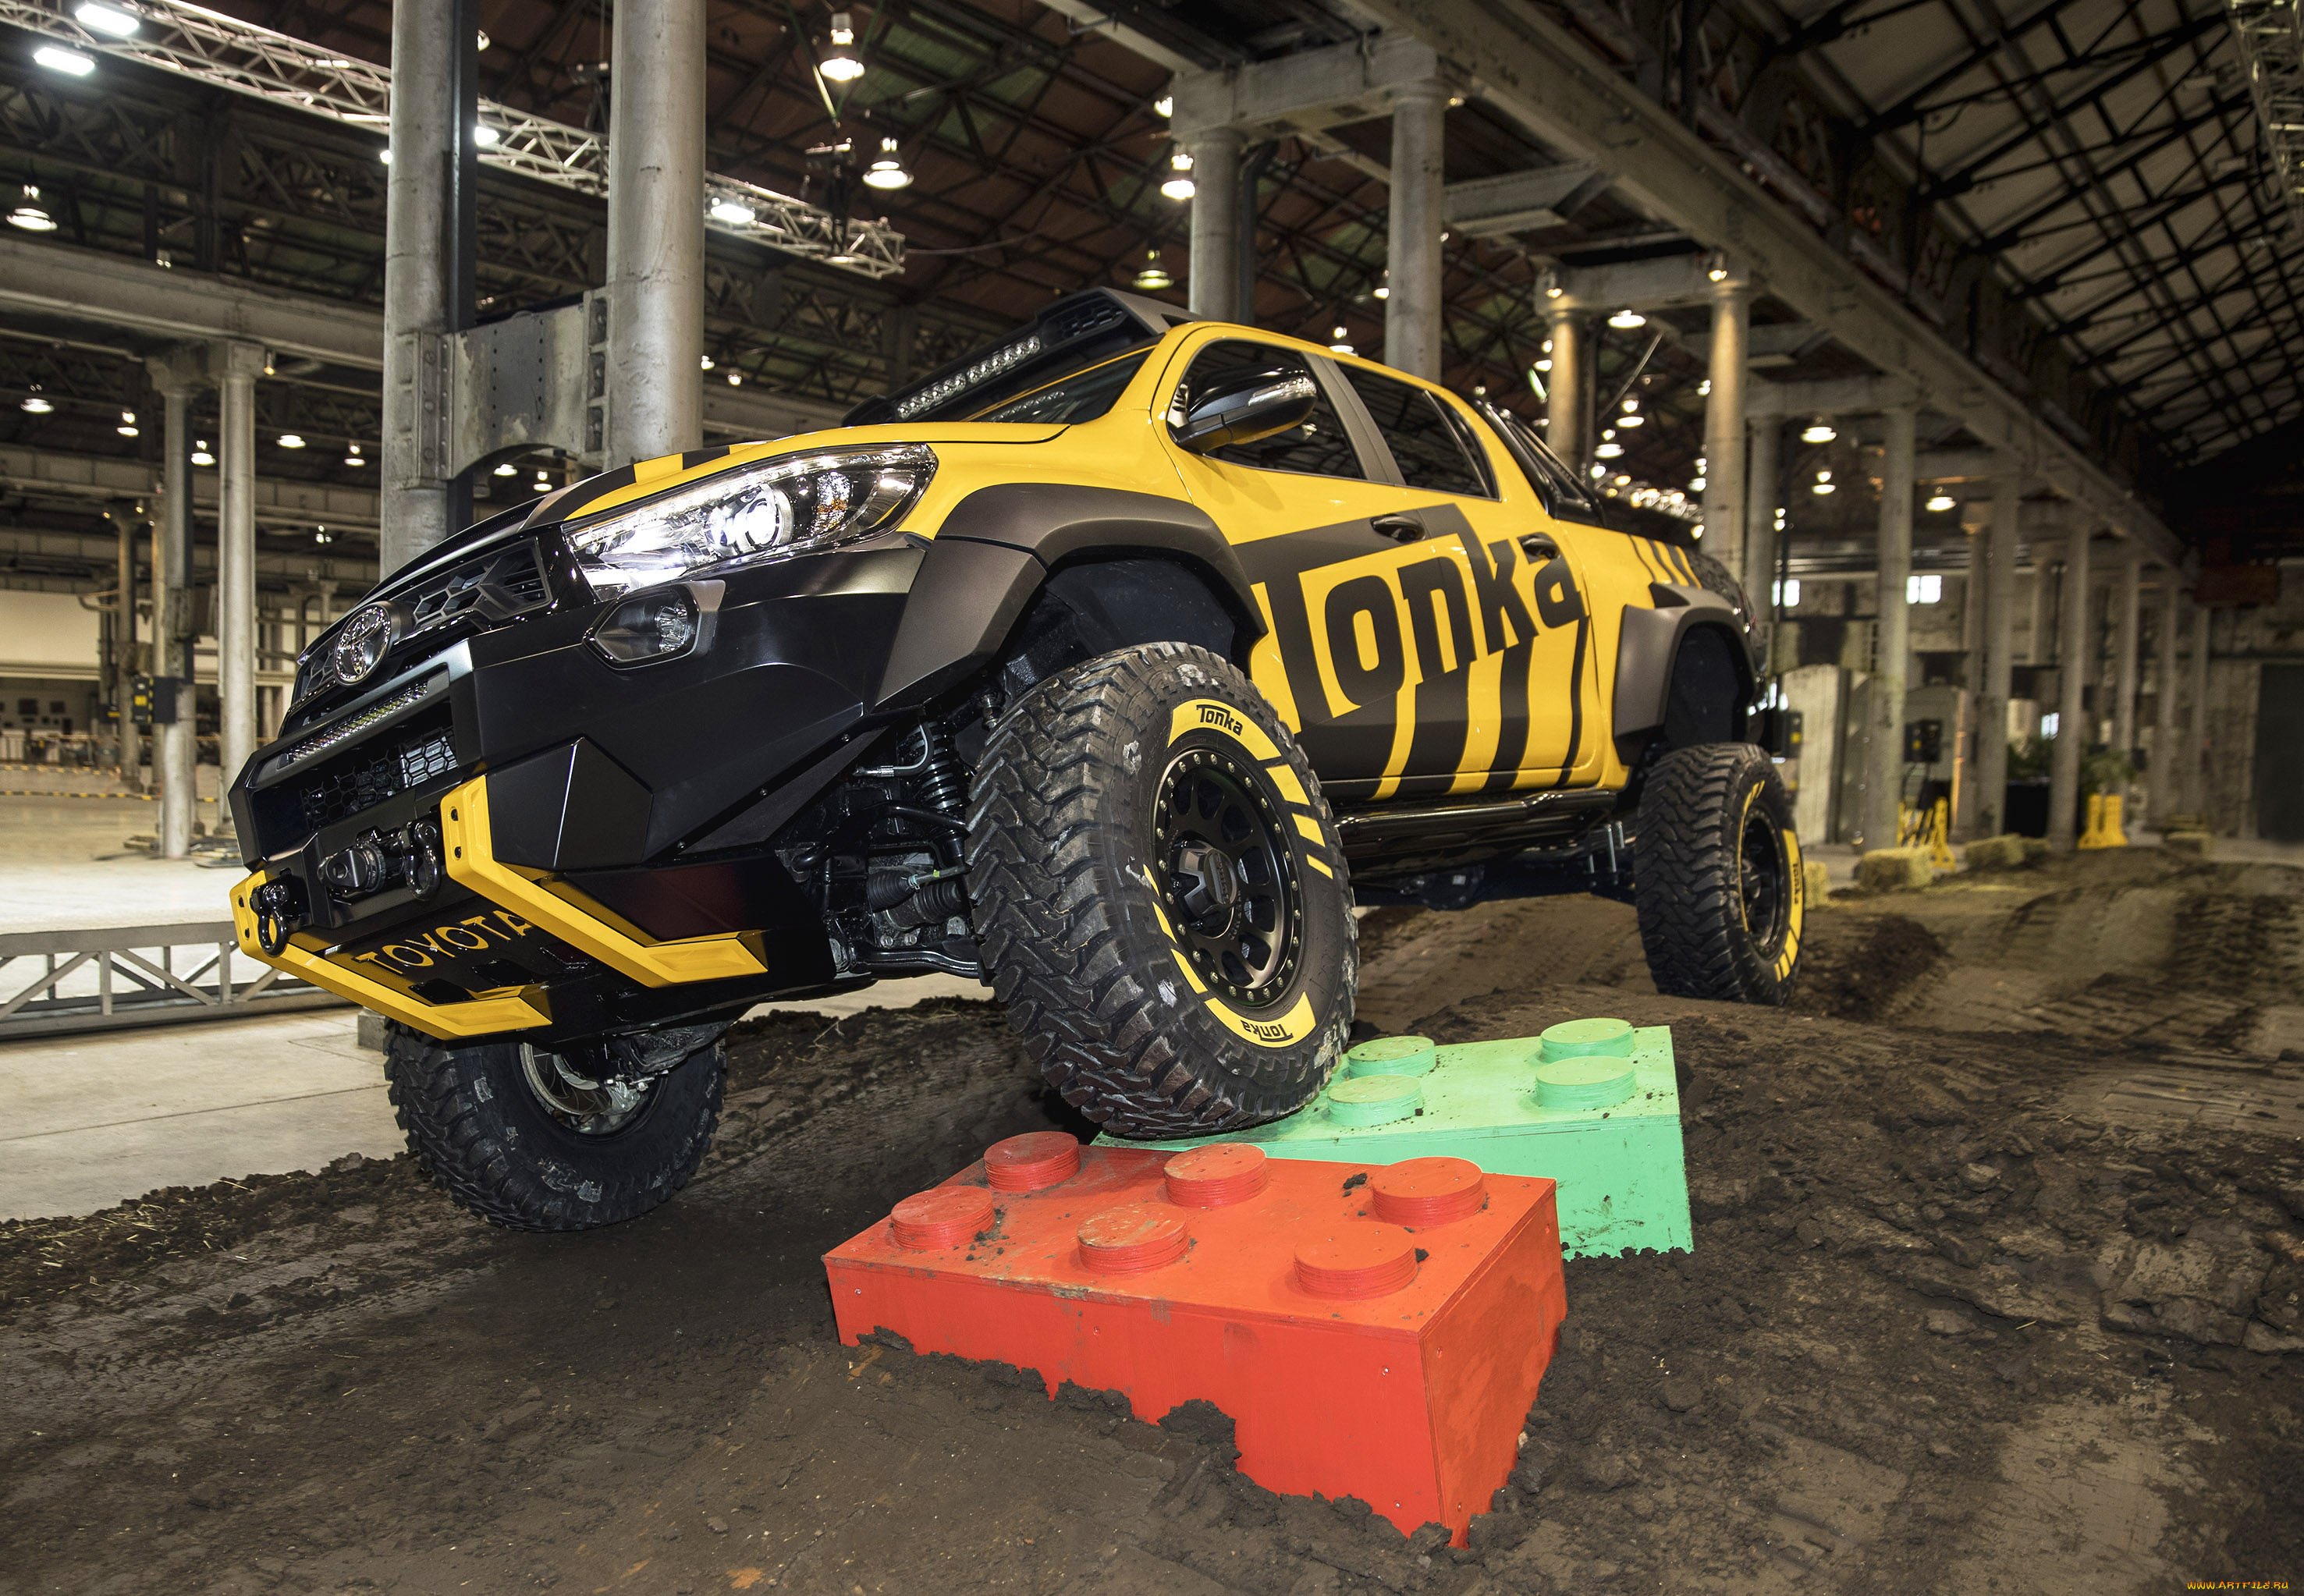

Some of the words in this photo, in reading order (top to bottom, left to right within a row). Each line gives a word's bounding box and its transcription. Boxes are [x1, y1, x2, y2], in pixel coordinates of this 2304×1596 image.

[1230, 503, 1585, 734] Tonka
[1196, 704, 1243, 736] Tonka
[353, 910, 534, 974] TOYOTA
[1241, 1020, 1294, 1042] Tonka
